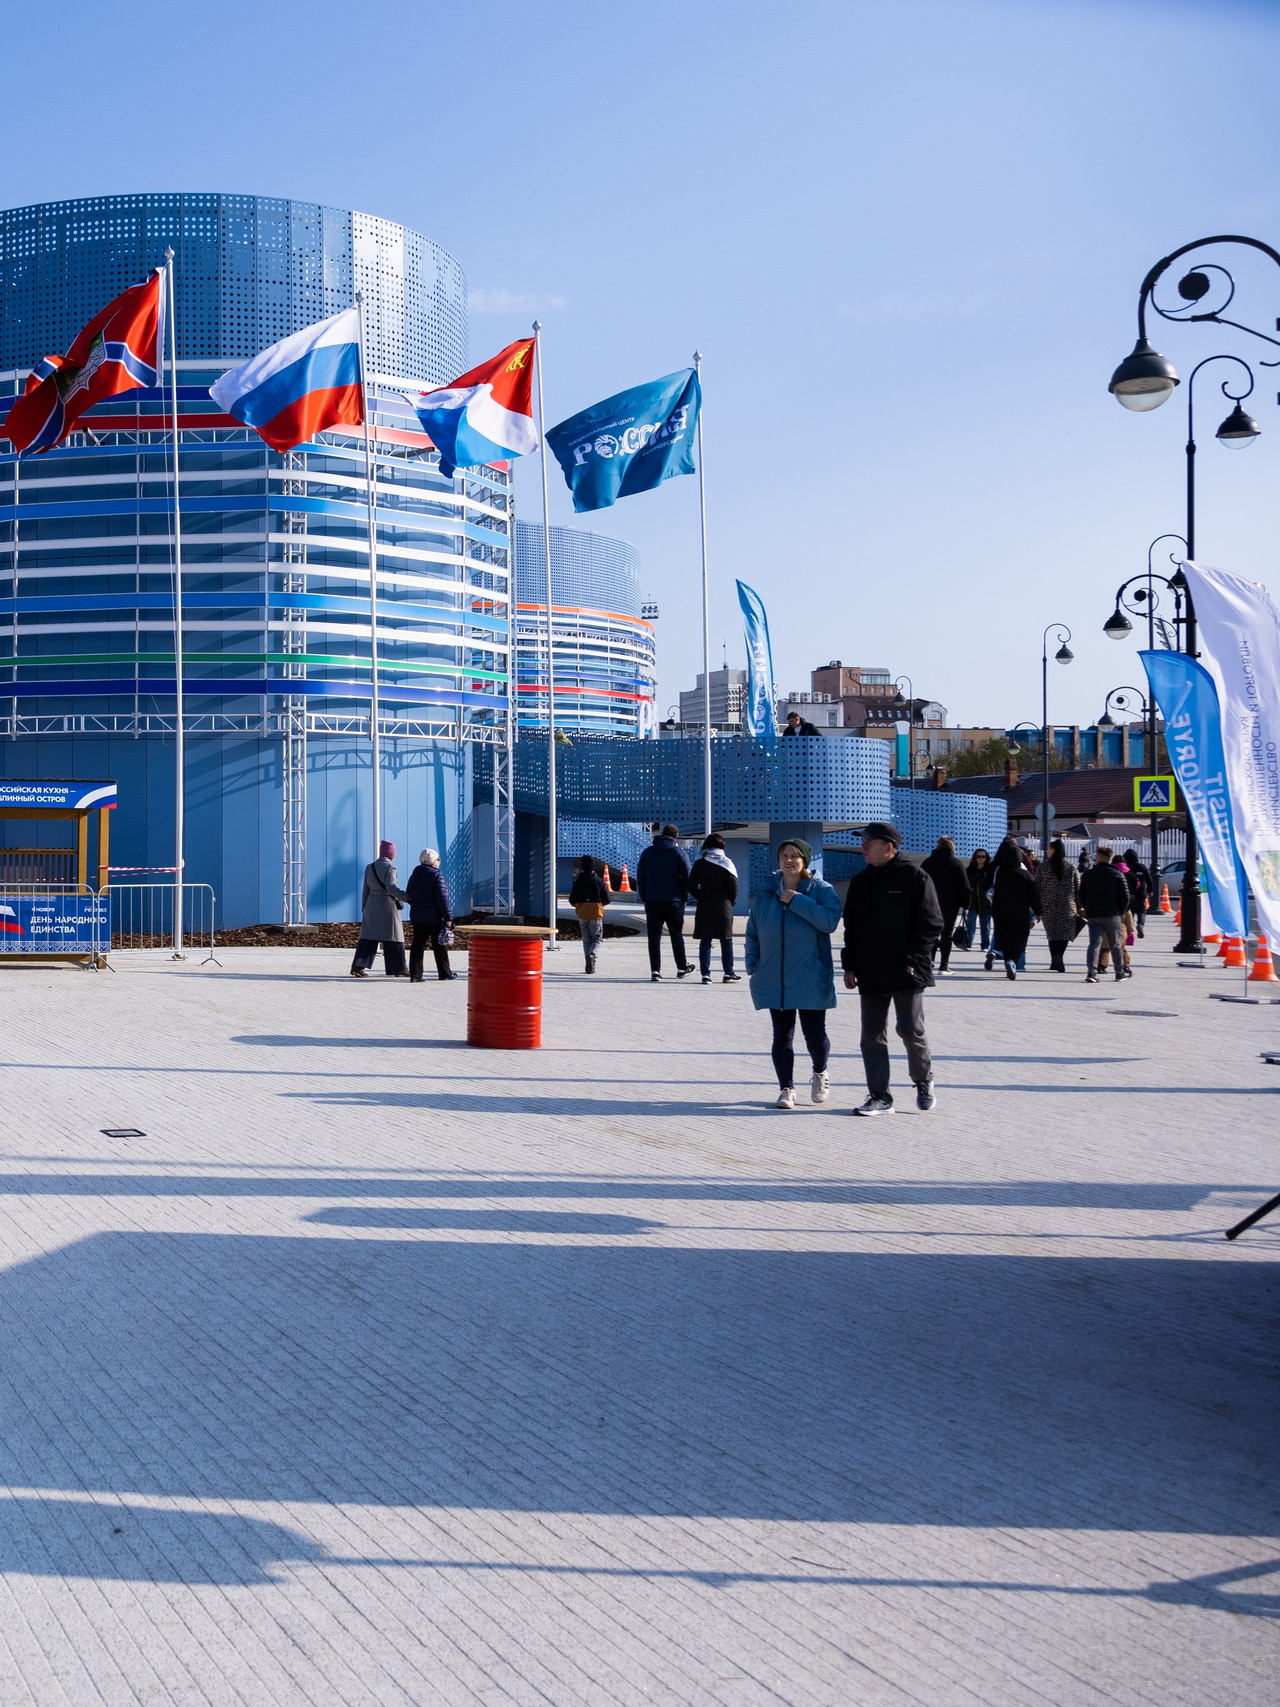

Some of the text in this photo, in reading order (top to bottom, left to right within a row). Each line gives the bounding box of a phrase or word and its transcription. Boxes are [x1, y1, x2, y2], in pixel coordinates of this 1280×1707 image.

[568, 417, 636, 446] НАЦИОНАЛЬНЫЙ ЦЕНТР
[30, 916, 53, 924] ДЕНЬ
